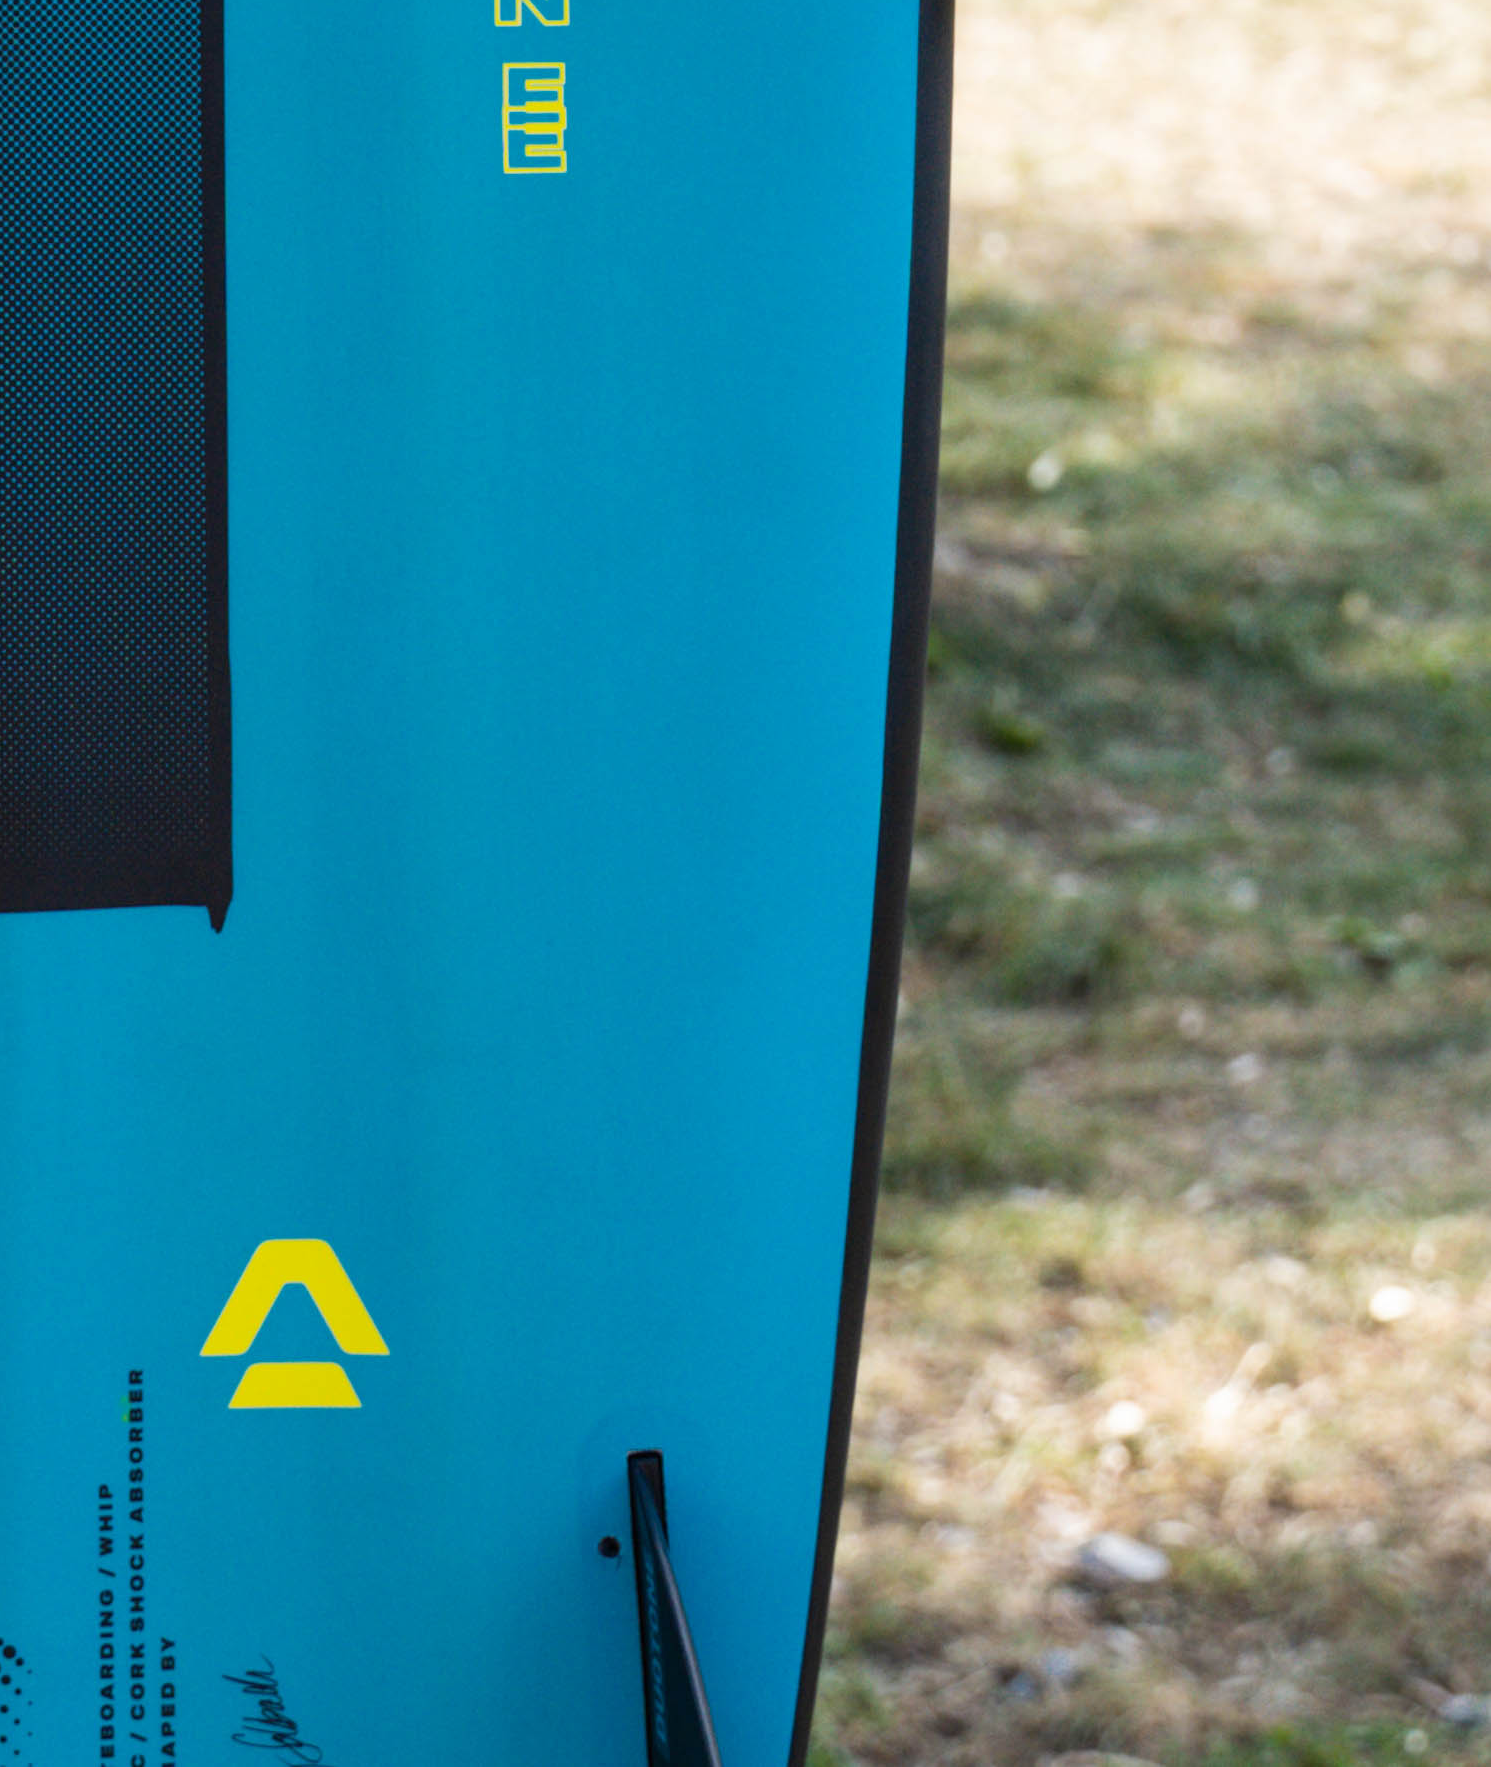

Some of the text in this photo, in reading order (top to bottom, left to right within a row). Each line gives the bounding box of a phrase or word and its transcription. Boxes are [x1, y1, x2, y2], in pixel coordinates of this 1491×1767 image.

[128, 1370, 144, 1523] ABSORBER
[98, 1484, 116, 1767] EBOARDING / WHIP
[129, 1535, 145, 1632] SHOCK
[130, 1642, 145, 1721] CORK
[160, 1637, 175, 1671] BY
